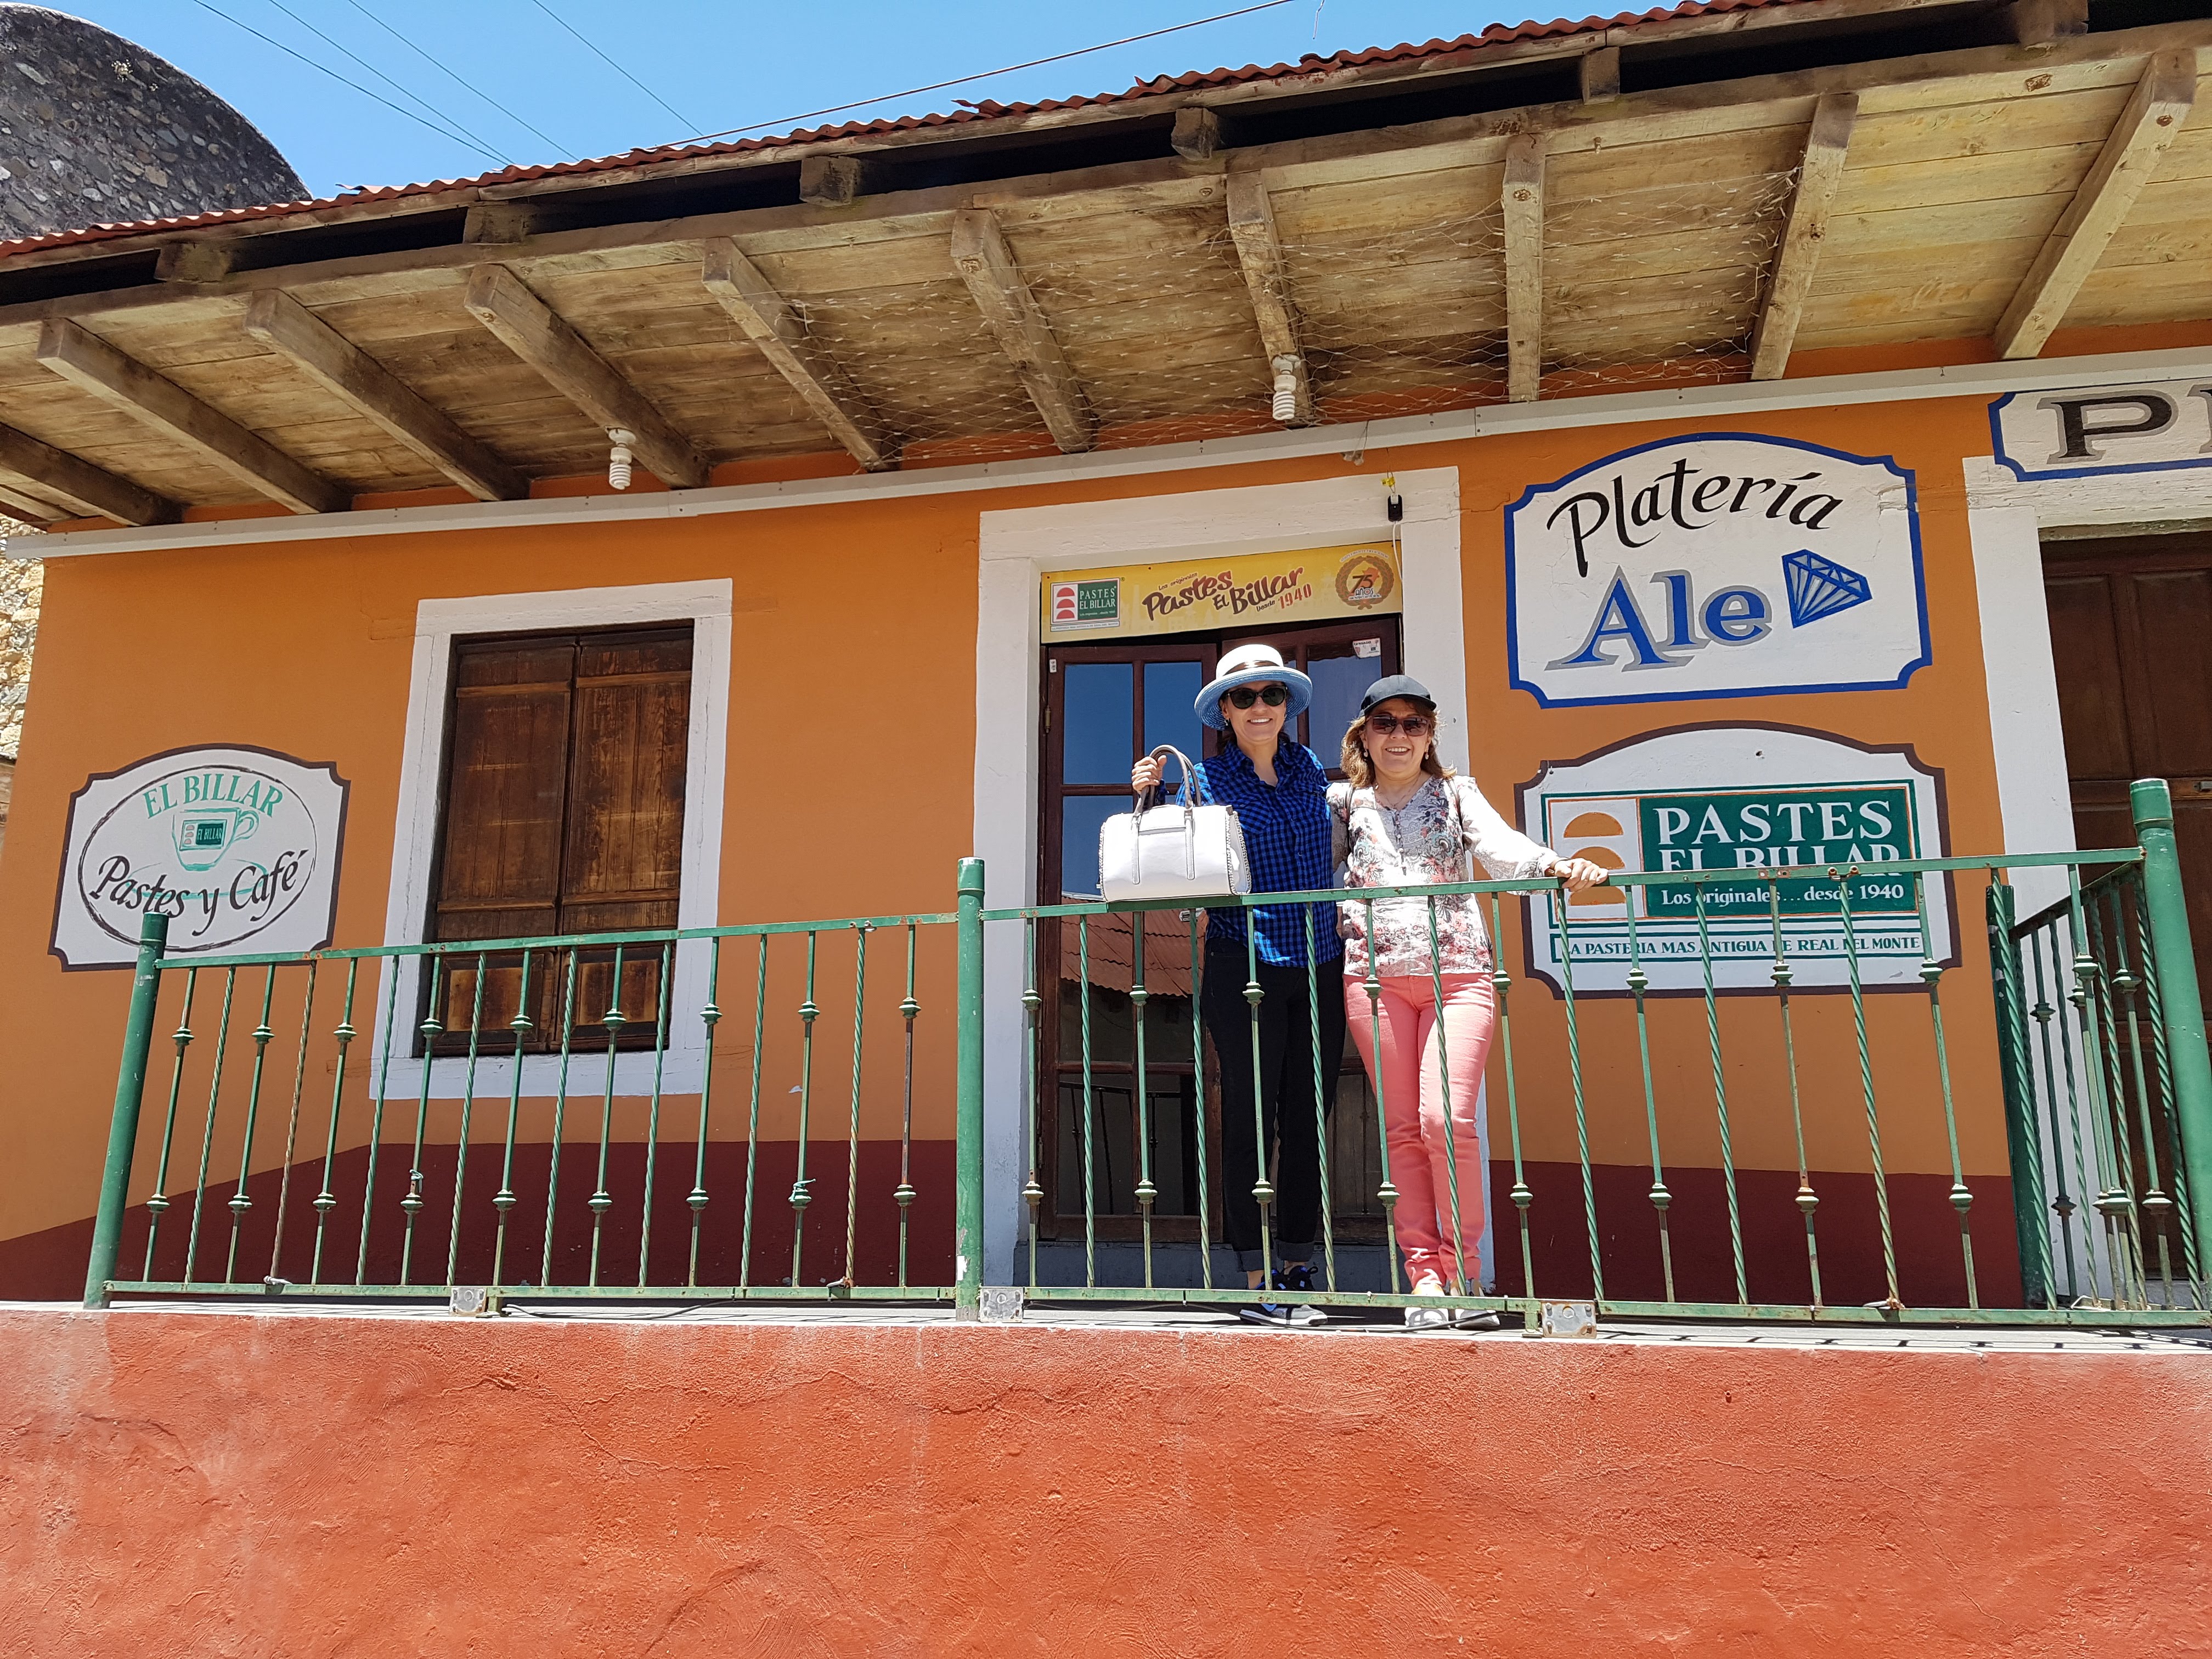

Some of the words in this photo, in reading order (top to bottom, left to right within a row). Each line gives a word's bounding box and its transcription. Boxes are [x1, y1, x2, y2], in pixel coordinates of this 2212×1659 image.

[1546, 457, 1843, 578] Platería
[1080, 588, 1115, 600] PASTES
[1142, 570, 1233, 621] Pastes
[1229, 567, 1304, 615] Billar
[1279, 584, 1312, 609] 1940
[1351, 575, 1373, 593] 75
[1080, 601, 1088, 610] EL
[1090, 598, 1116, 609] BILLAR
[1544, 565, 1773, 672] Ale
[143, 783, 178, 819] EL
[183, 774, 284, 818] BILLAR
[204, 828, 223, 840] BILLAR
[1654, 800, 1894, 845] PASTES
[89, 855, 191, 917] Pastes
[192, 888, 220, 936] y
[230, 849, 310, 922] Café
[1661, 890, 1691, 905] Los
[1804, 887, 1854, 901] desde
[1860, 884, 1904, 899] 1940
[1662, 941, 1695, 953] MAS
[1699, 940, 1767, 952] NTIGUA
[1772, 940, 1792, 952] E
[1797, 939, 1839, 951] REAL
[1872, 937, 1920, 949] MONTE
